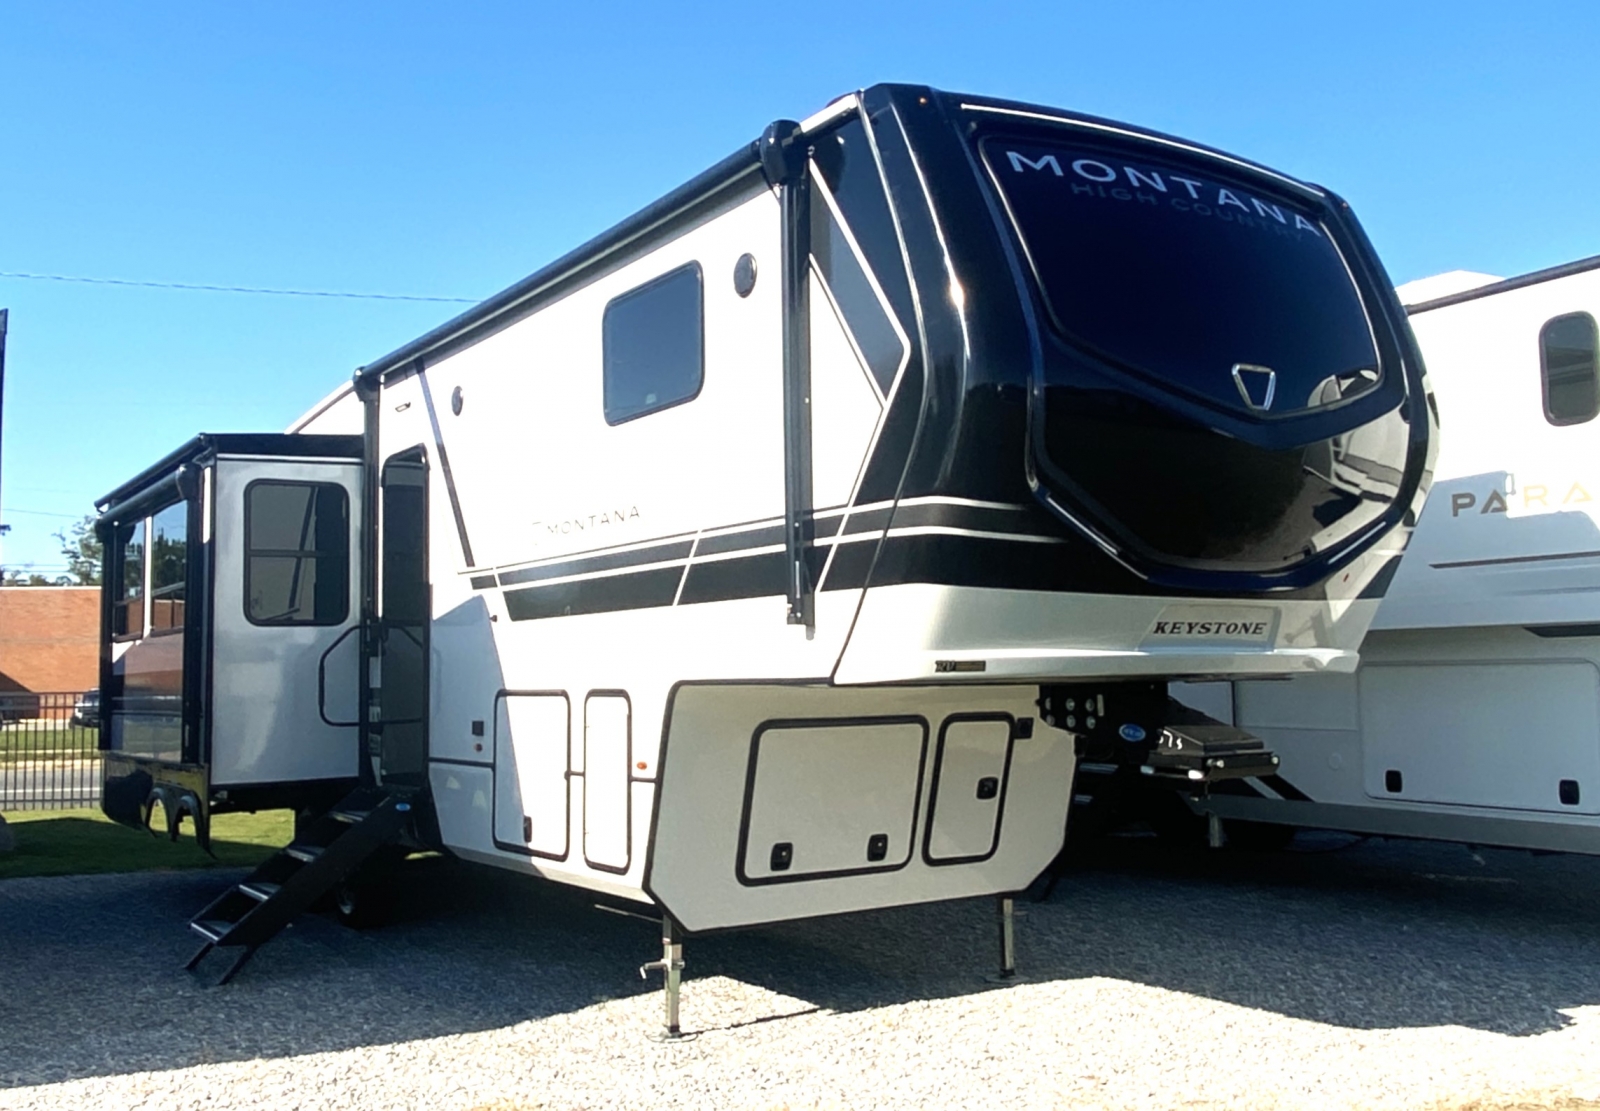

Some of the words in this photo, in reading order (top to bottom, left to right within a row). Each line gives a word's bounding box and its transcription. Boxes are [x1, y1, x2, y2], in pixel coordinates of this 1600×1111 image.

[1006, 151, 1321, 237] MONTANA
[1071, 182, 1159, 206] HIGH
[548, 505, 640, 535] MONTANA
[1153, 621, 1267, 635] KEYSTONE
